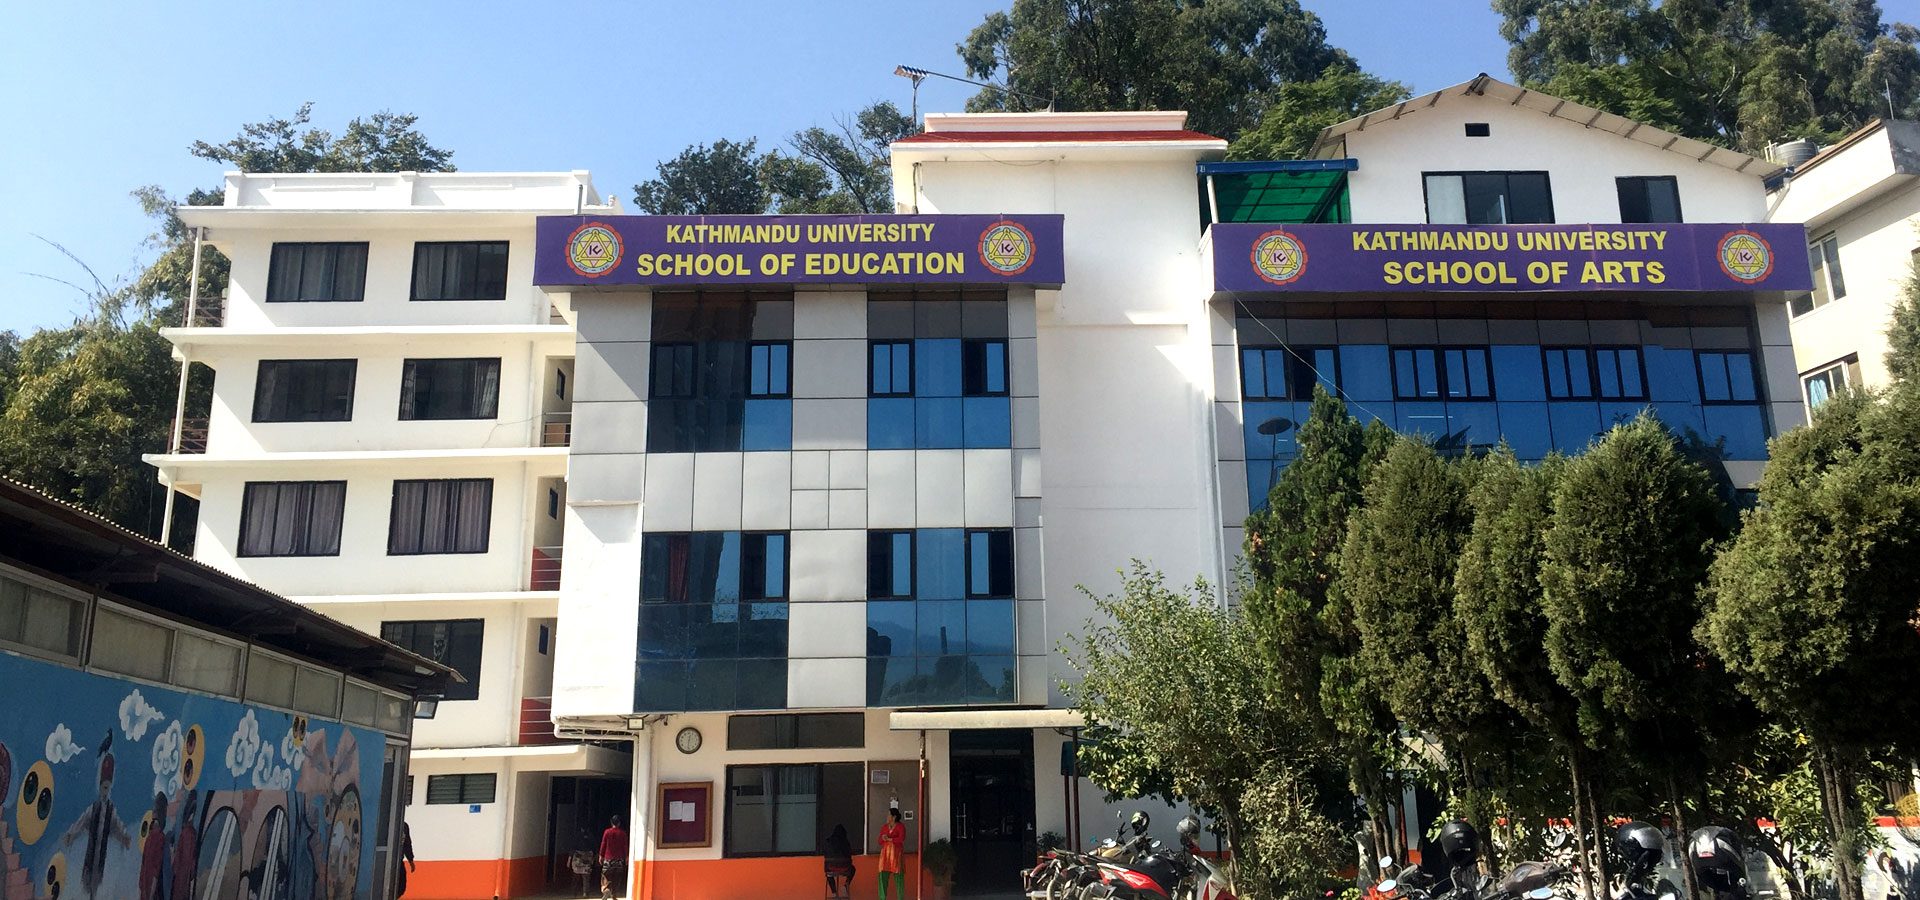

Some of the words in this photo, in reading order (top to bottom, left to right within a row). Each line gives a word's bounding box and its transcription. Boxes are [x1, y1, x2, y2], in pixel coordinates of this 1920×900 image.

[666, 224, 801, 244] KATHMANDU
[807, 223, 935, 243] UNIVERSITY
[1352, 231, 1509, 251] KATHMANDU
[1516, 230, 1666, 251] UNIVERSITY
[636, 253, 752, 276] SCHOOL
[759, 253, 796, 276] OF
[805, 252, 965, 275] EDUCATION
[1383, 261, 1518, 285] SCHOOL
[1526, 261, 1569, 284] OF
[1580, 260, 1666, 284] ARTS
